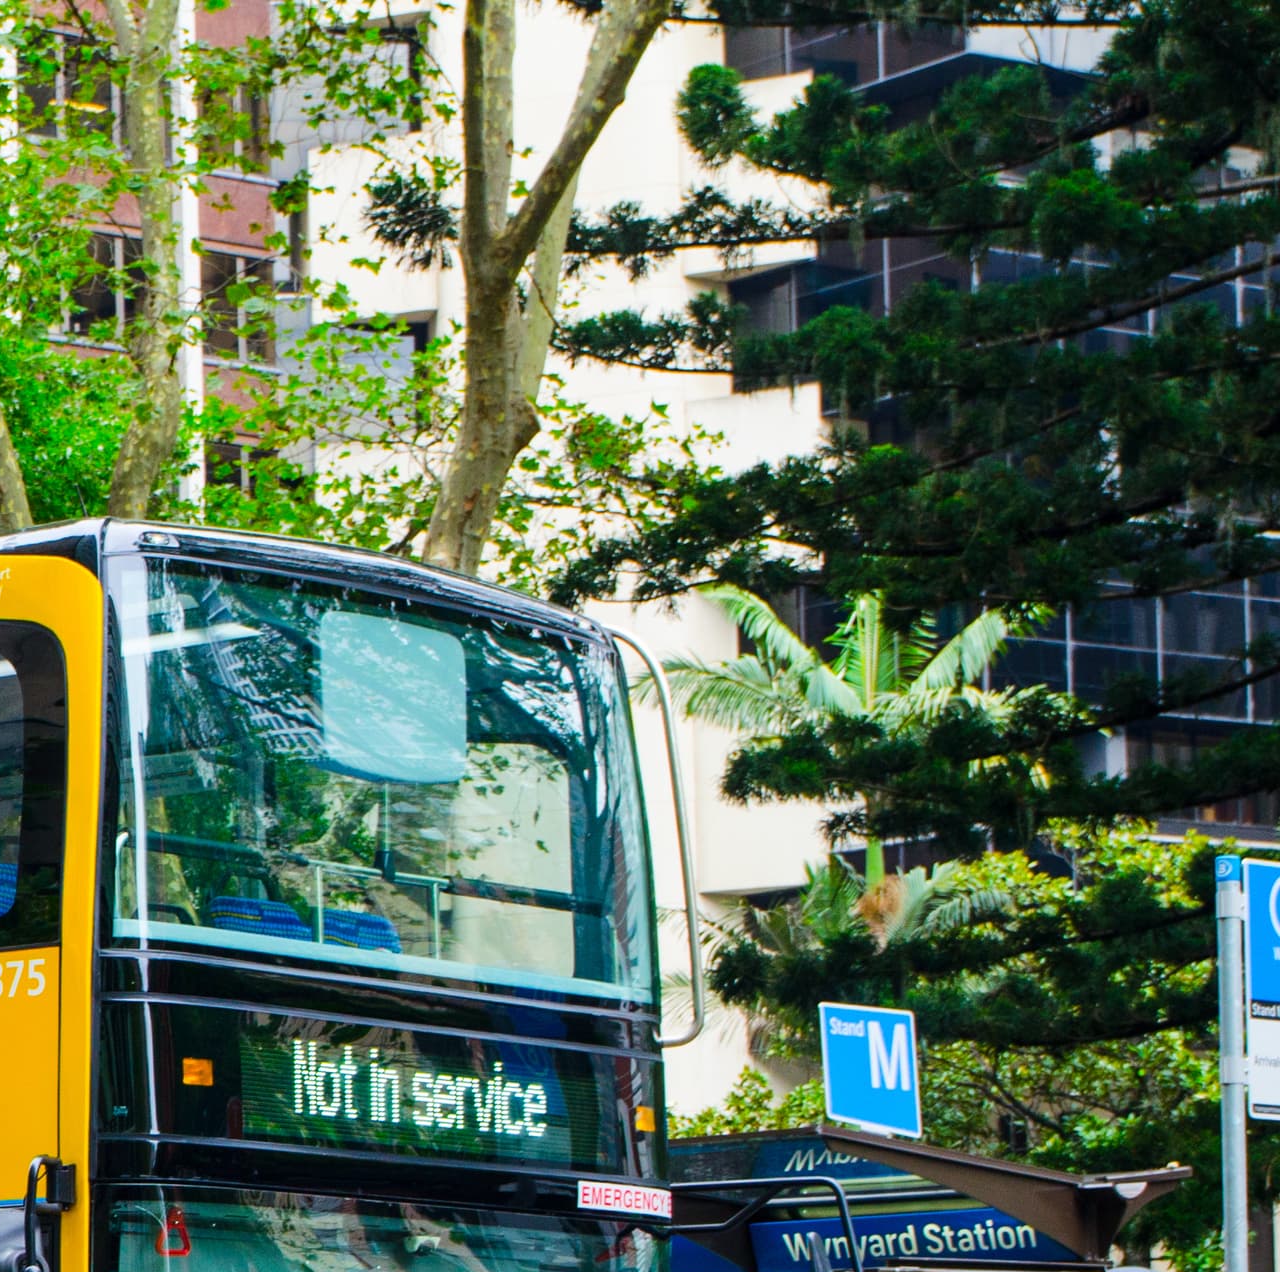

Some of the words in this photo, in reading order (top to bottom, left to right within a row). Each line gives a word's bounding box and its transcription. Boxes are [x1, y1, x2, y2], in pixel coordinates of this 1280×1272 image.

[1251, 1002, 1276, 1018] Stand
[829, 1016, 865, 1037] Stand
[867, 1021, 911, 1091] M
[293, 1039, 358, 1119] Not
[370, 1048, 400, 1123] in
[412, 1061, 547, 1137] service
[581, 1186, 665, 1214] EMERGENCY
[922, 1219, 1037, 1254] Station
